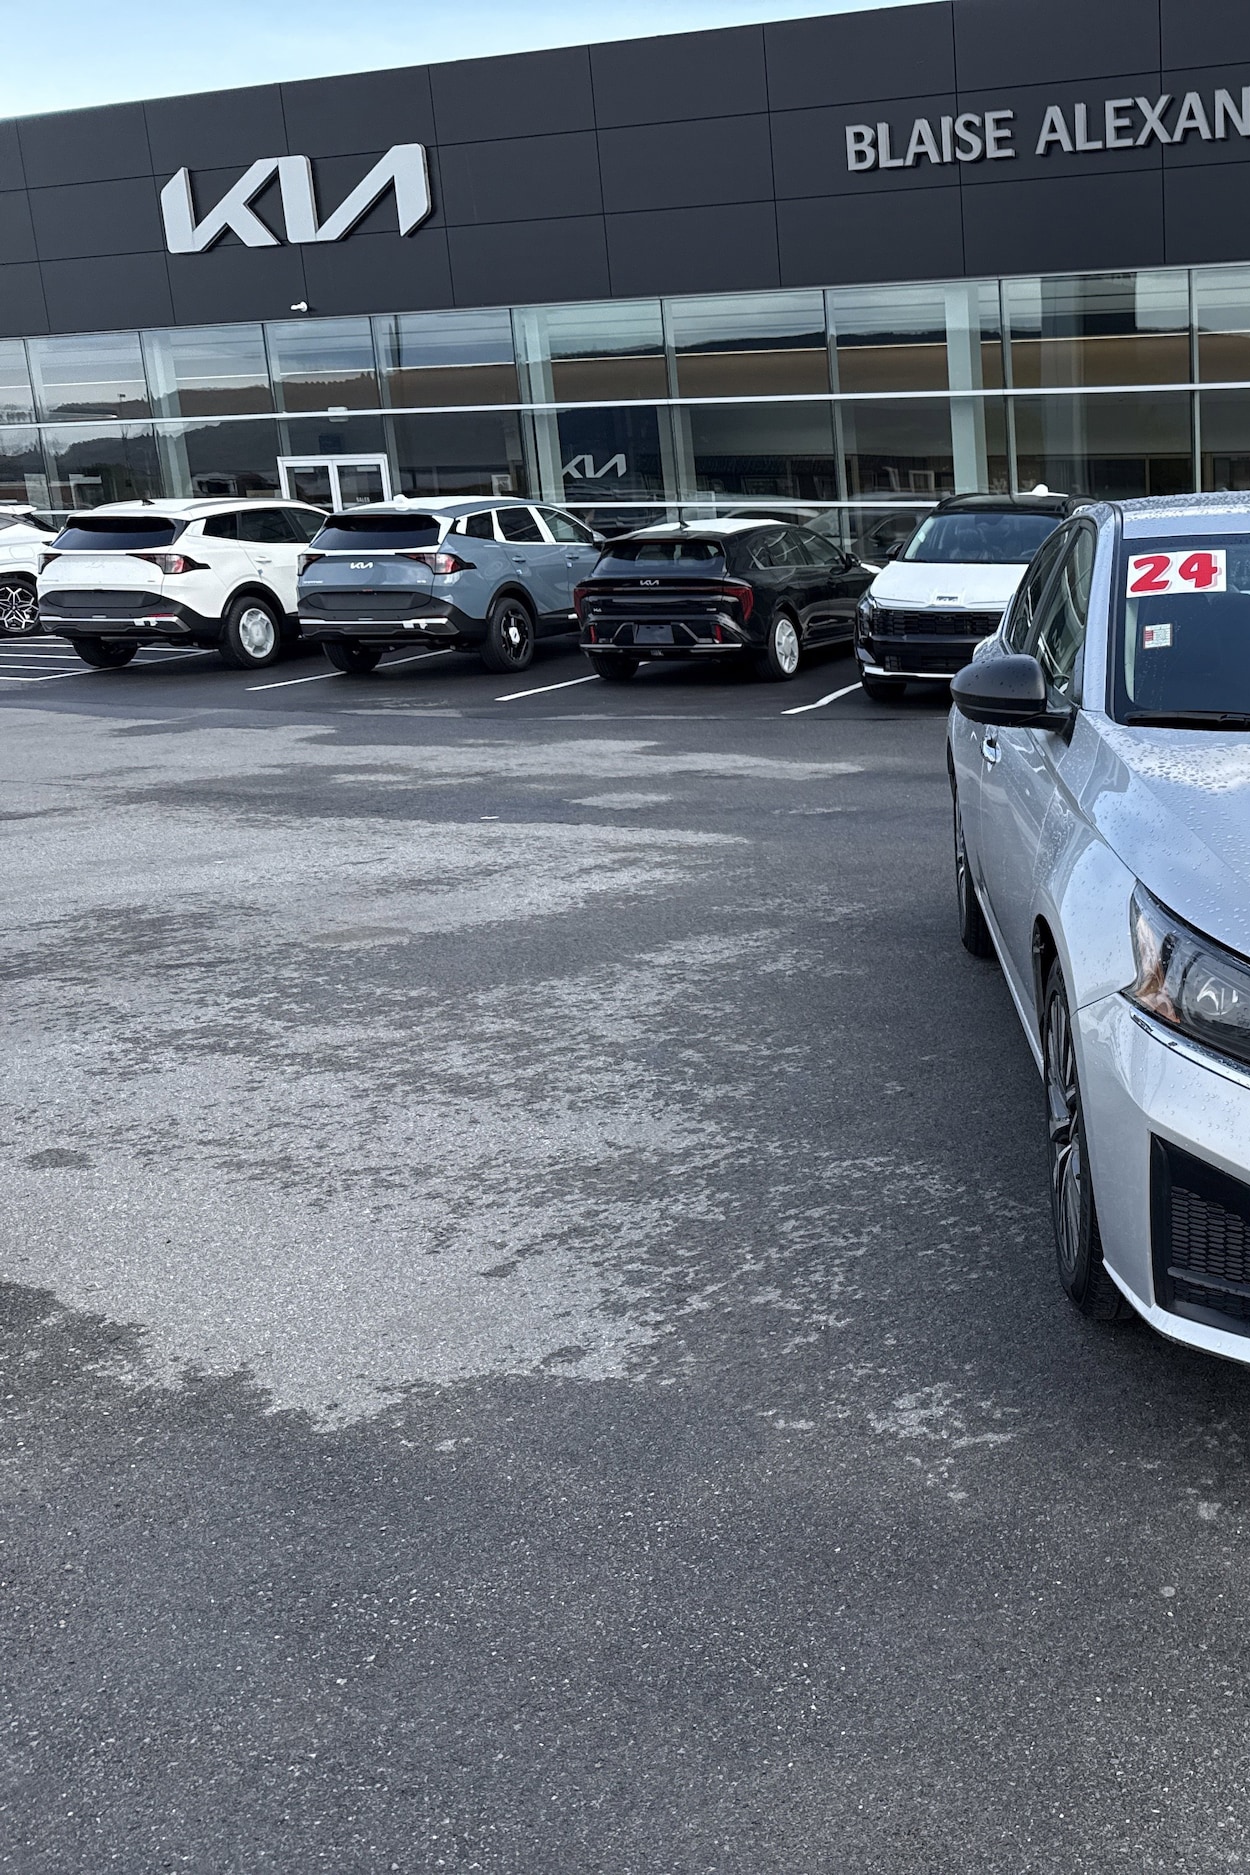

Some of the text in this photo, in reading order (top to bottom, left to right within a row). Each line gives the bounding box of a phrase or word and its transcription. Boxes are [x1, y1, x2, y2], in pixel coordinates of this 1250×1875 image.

[845, 109, 1016, 171] BLAISE
[160, 142, 432, 254] KIA
[1130, 553, 1219, 592] 24
